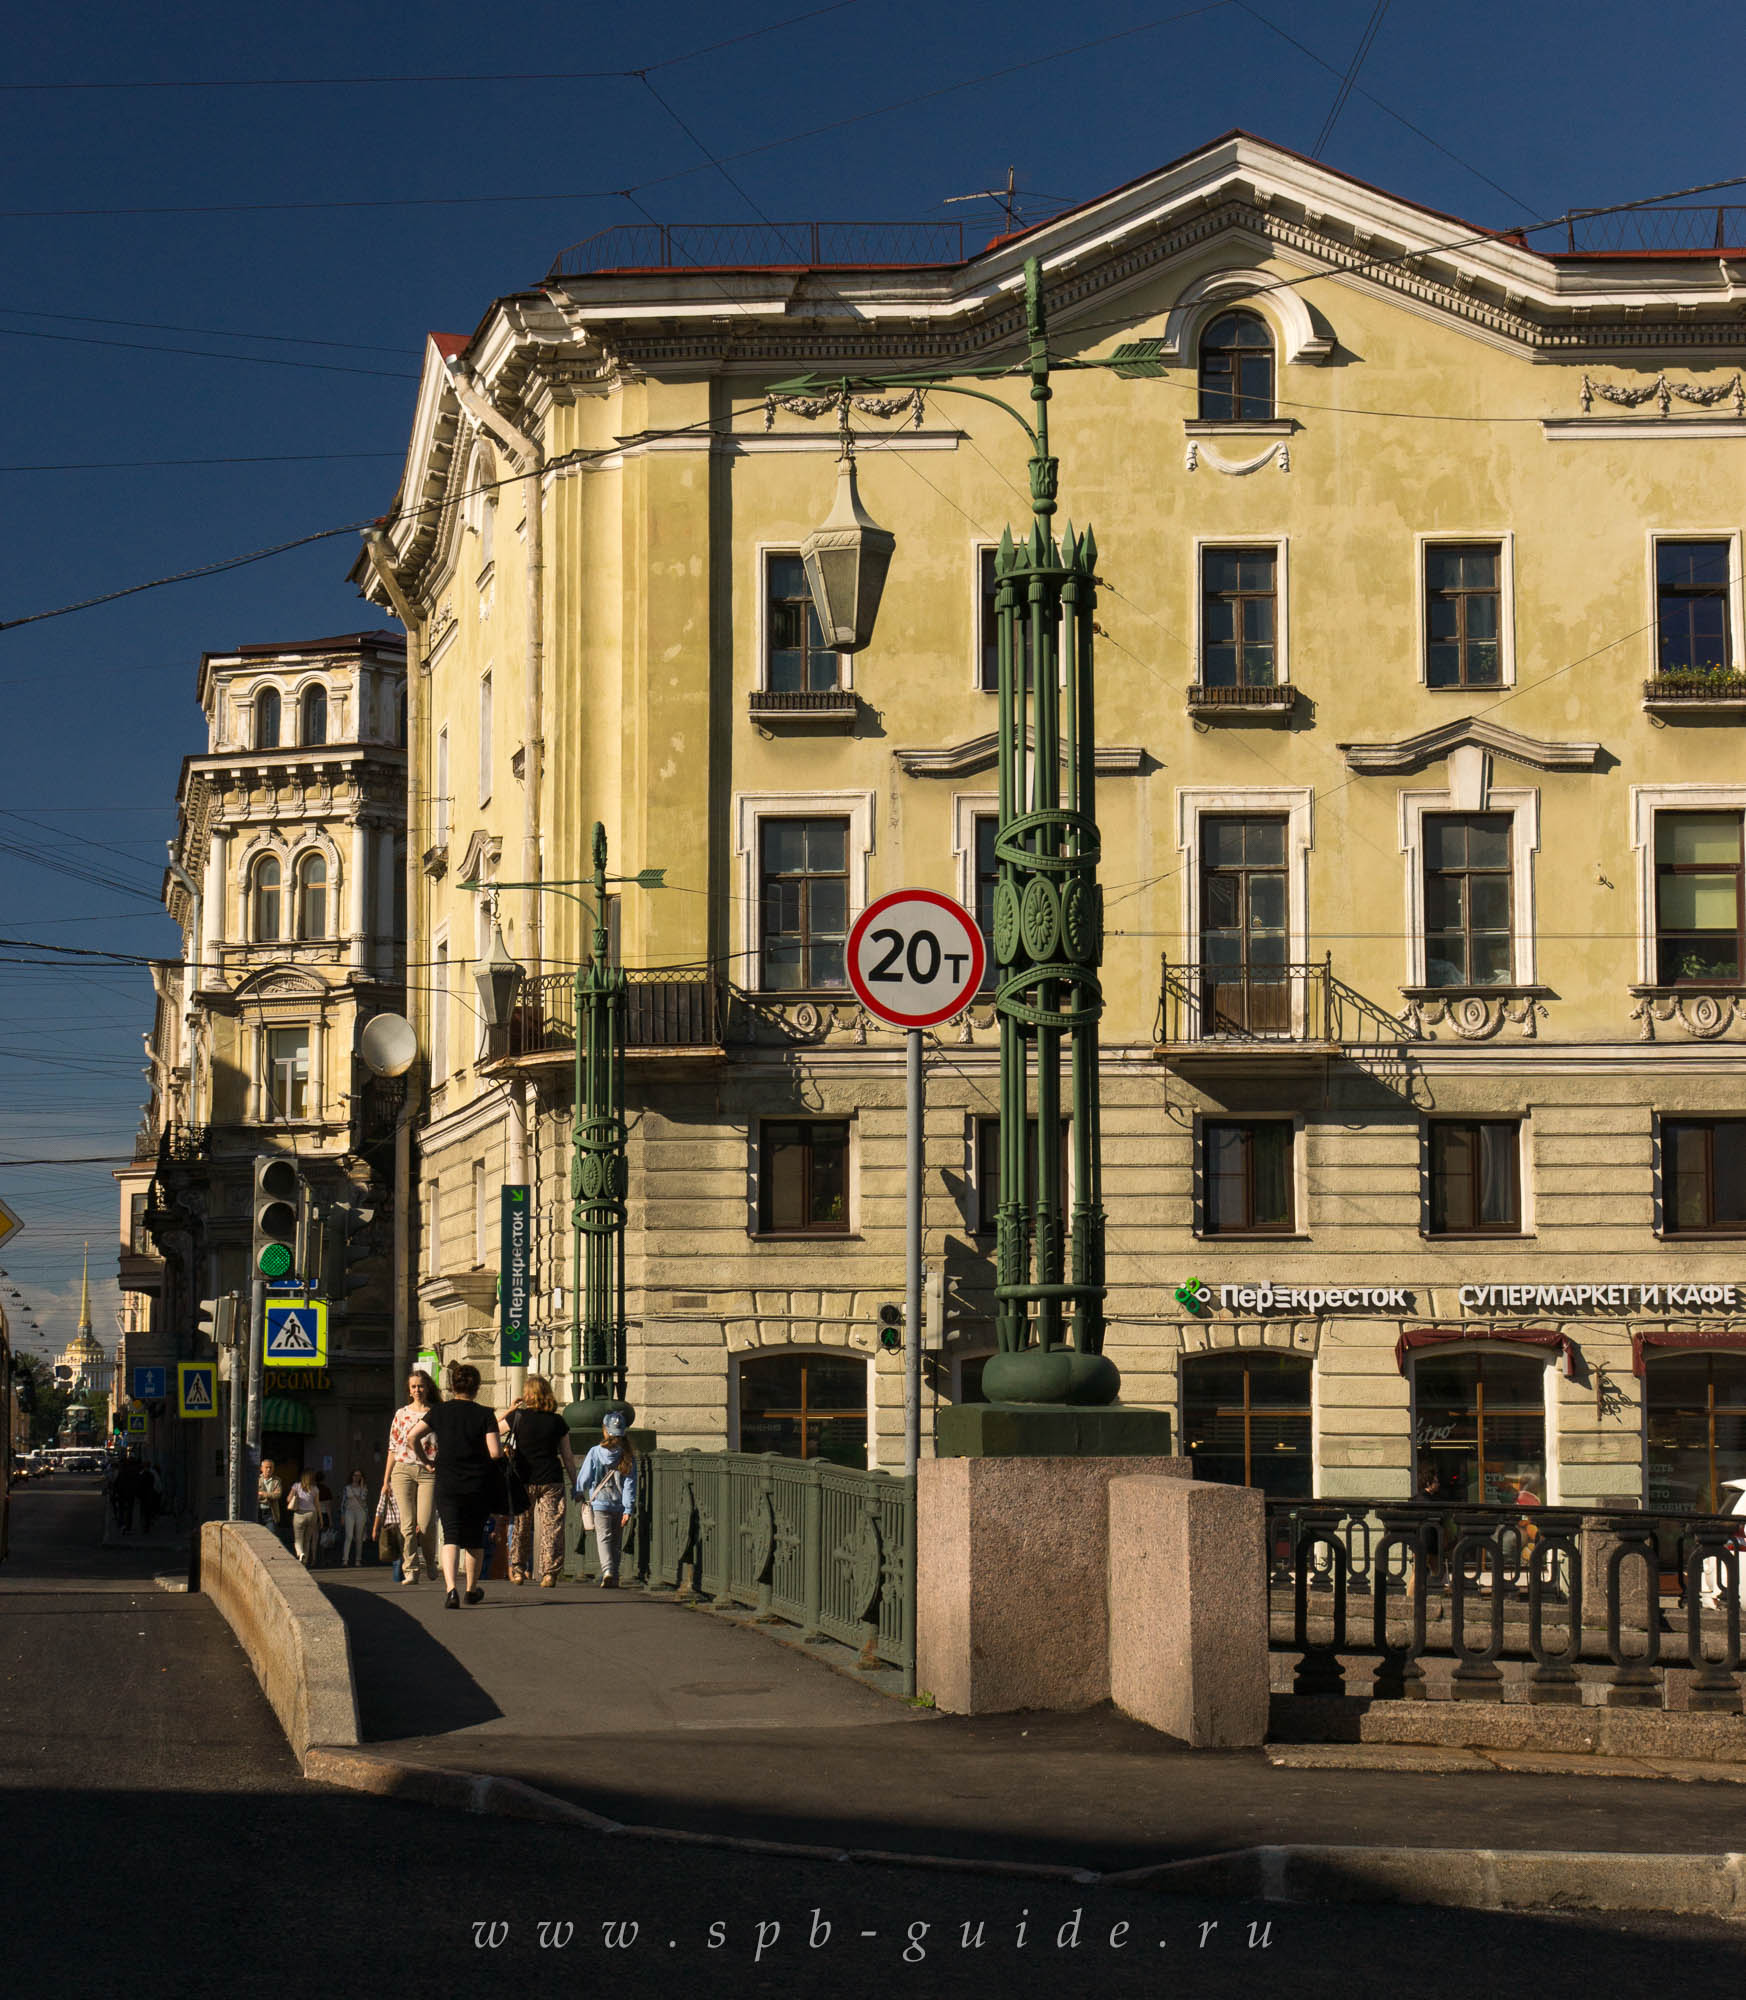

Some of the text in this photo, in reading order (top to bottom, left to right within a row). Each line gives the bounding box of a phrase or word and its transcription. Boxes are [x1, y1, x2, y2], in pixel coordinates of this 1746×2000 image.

[1458, 1284, 1736, 1306] СУПЕРМАРКЕТ И КАФЕ
